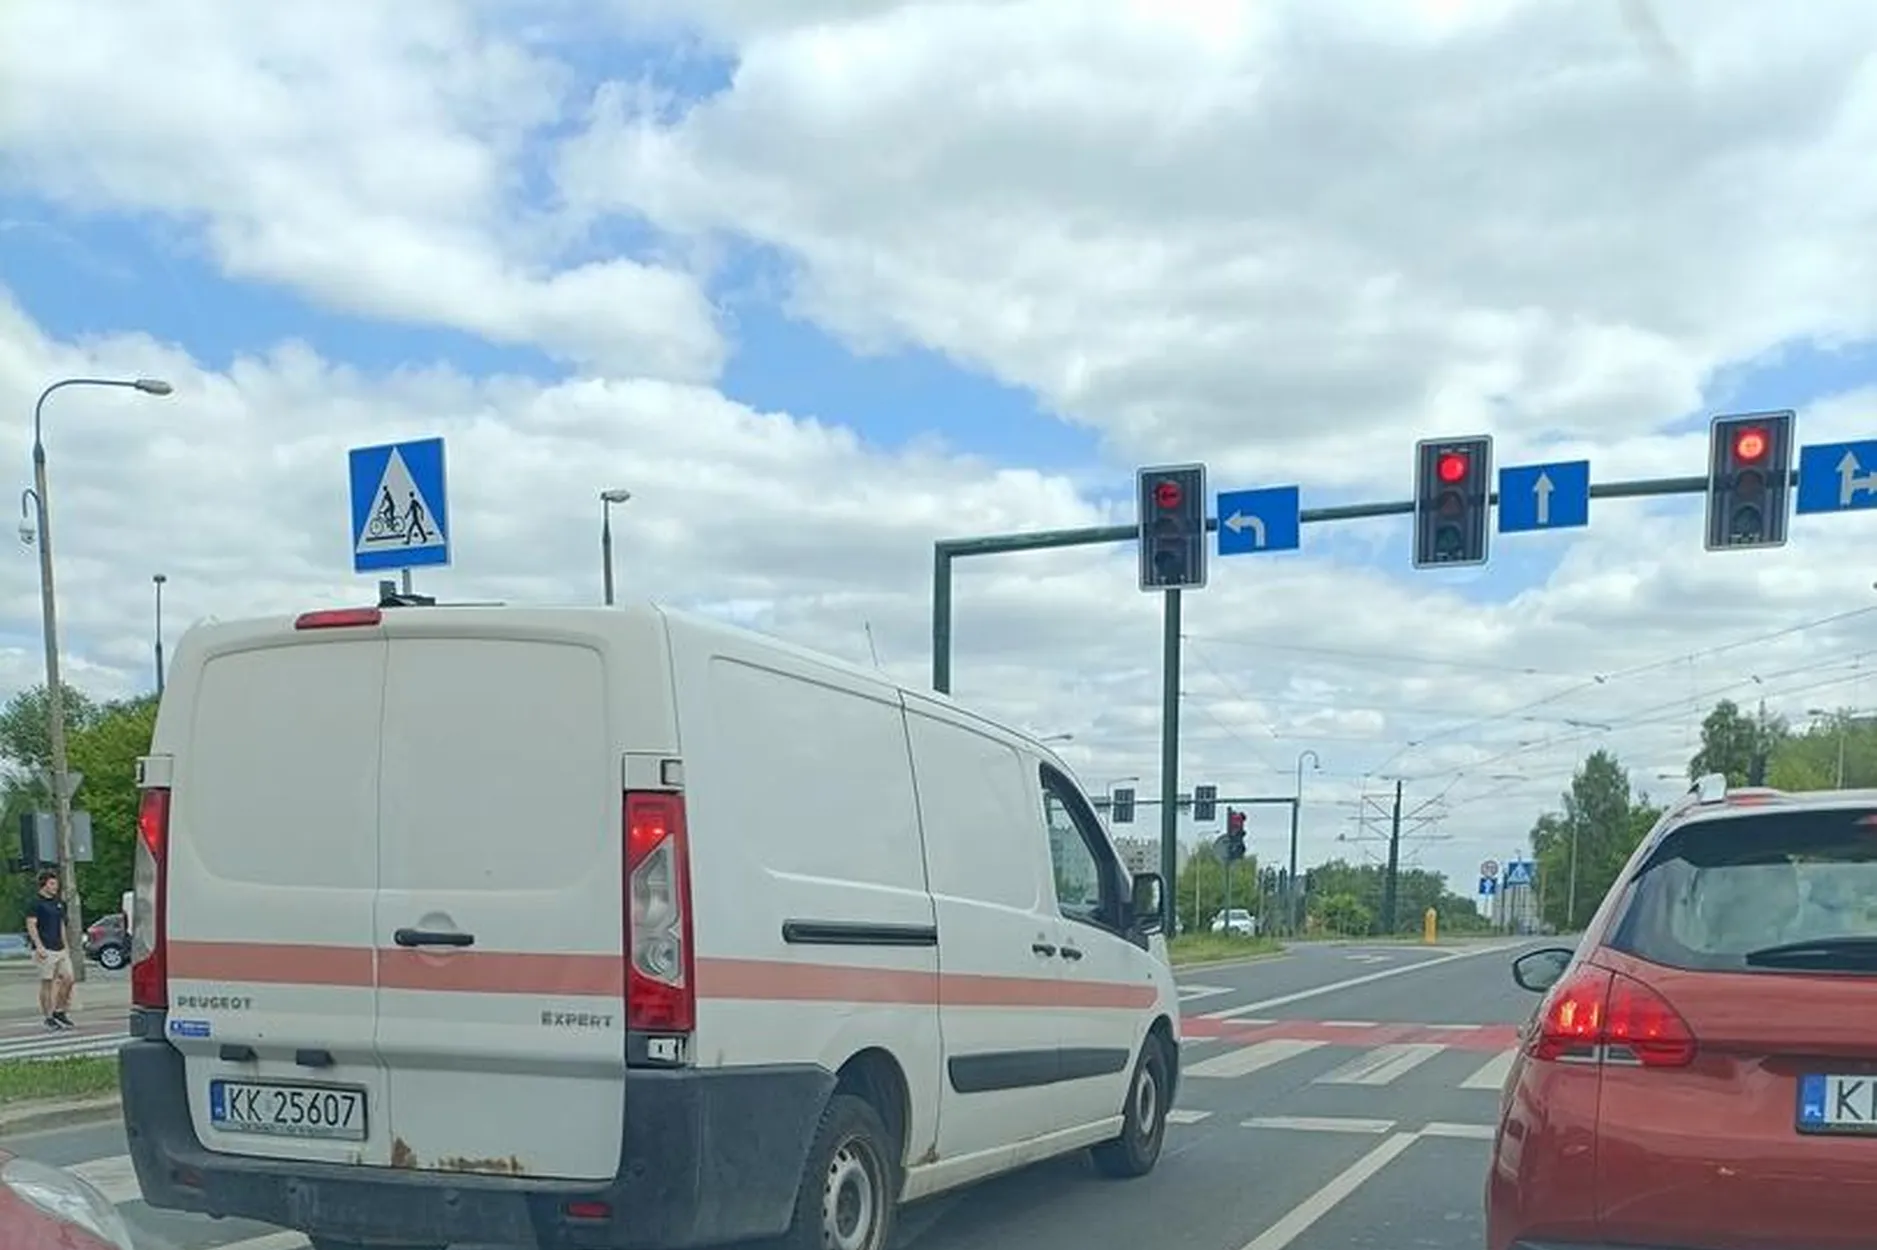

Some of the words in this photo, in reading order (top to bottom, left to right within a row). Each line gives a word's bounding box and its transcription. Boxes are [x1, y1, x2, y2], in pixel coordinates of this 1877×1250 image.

[177, 996, 253, 1009] PEUGEOT
[541, 1010, 613, 1028] EXPERT
[229, 1087, 262, 1122] KK
[273, 1091, 356, 1128] 25607
[1836, 1079, 1877, 1121] K
